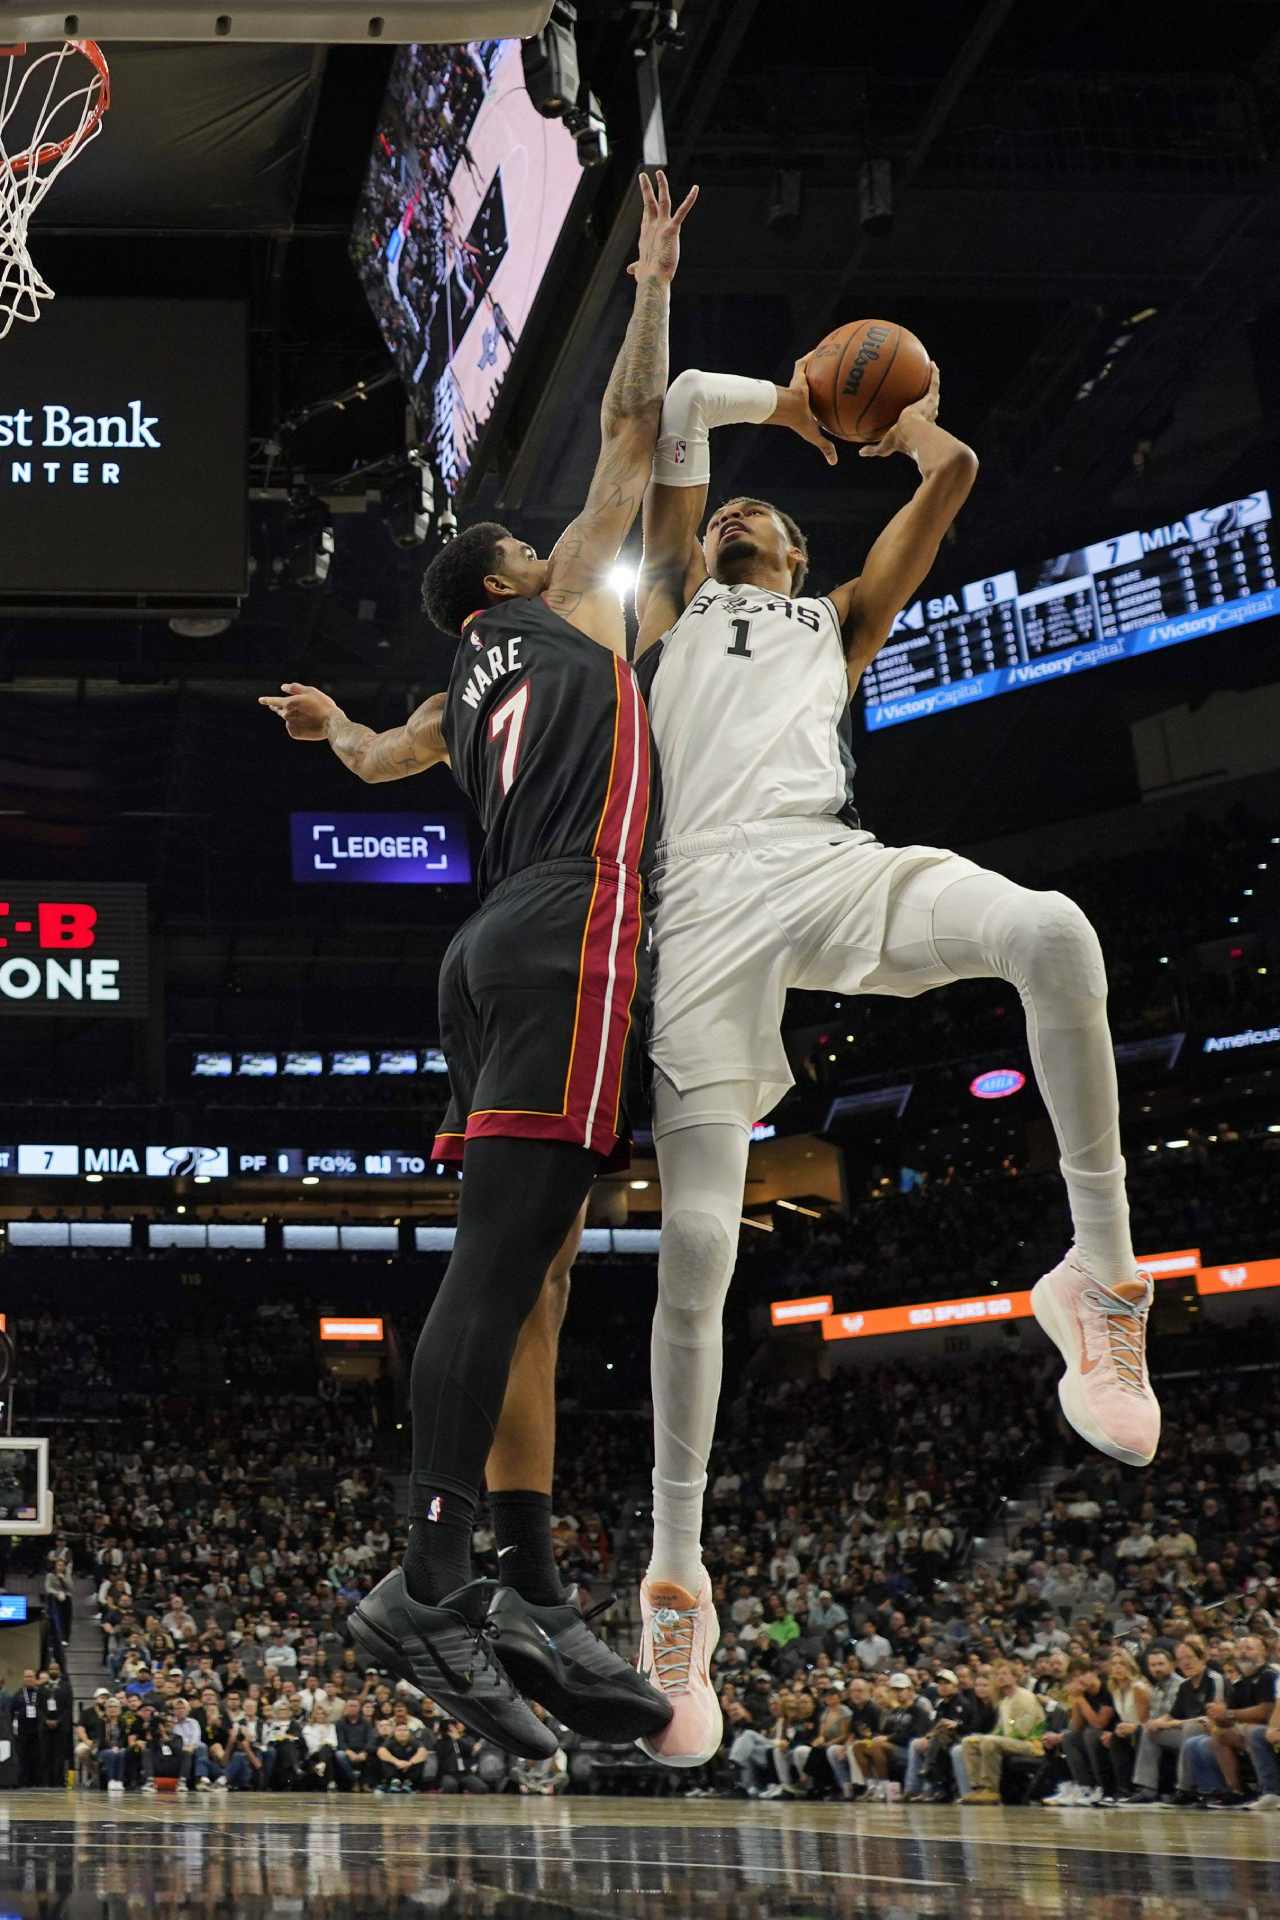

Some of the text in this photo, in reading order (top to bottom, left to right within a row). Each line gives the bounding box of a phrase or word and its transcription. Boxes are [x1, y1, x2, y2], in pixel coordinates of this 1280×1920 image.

[842, 326, 890, 396] Wilson
[42, 400, 161, 448] Bank
[11, 462, 120, 484] NTER
[1106, 521, 1191, 565] 7 MIA
[926, 594, 960, 620] SA
[983, 582, 997, 602] 9
[726, 618, 752, 658] 1
[462, 636, 522, 709] WARE
[489, 679, 531, 799] 7
[332, 837, 428, 858] LEDGER
[0, 902, 97, 949] -B
[0, 957, 120, 1000] ONE
[41, 1151, 55, 1169] 7
[85, 1148, 139, 1173] MIA
[239, 1155, 267, 1172] PF
[307, 1155, 357, 1174] FG%
[396, 1156, 425, 1174] TO
